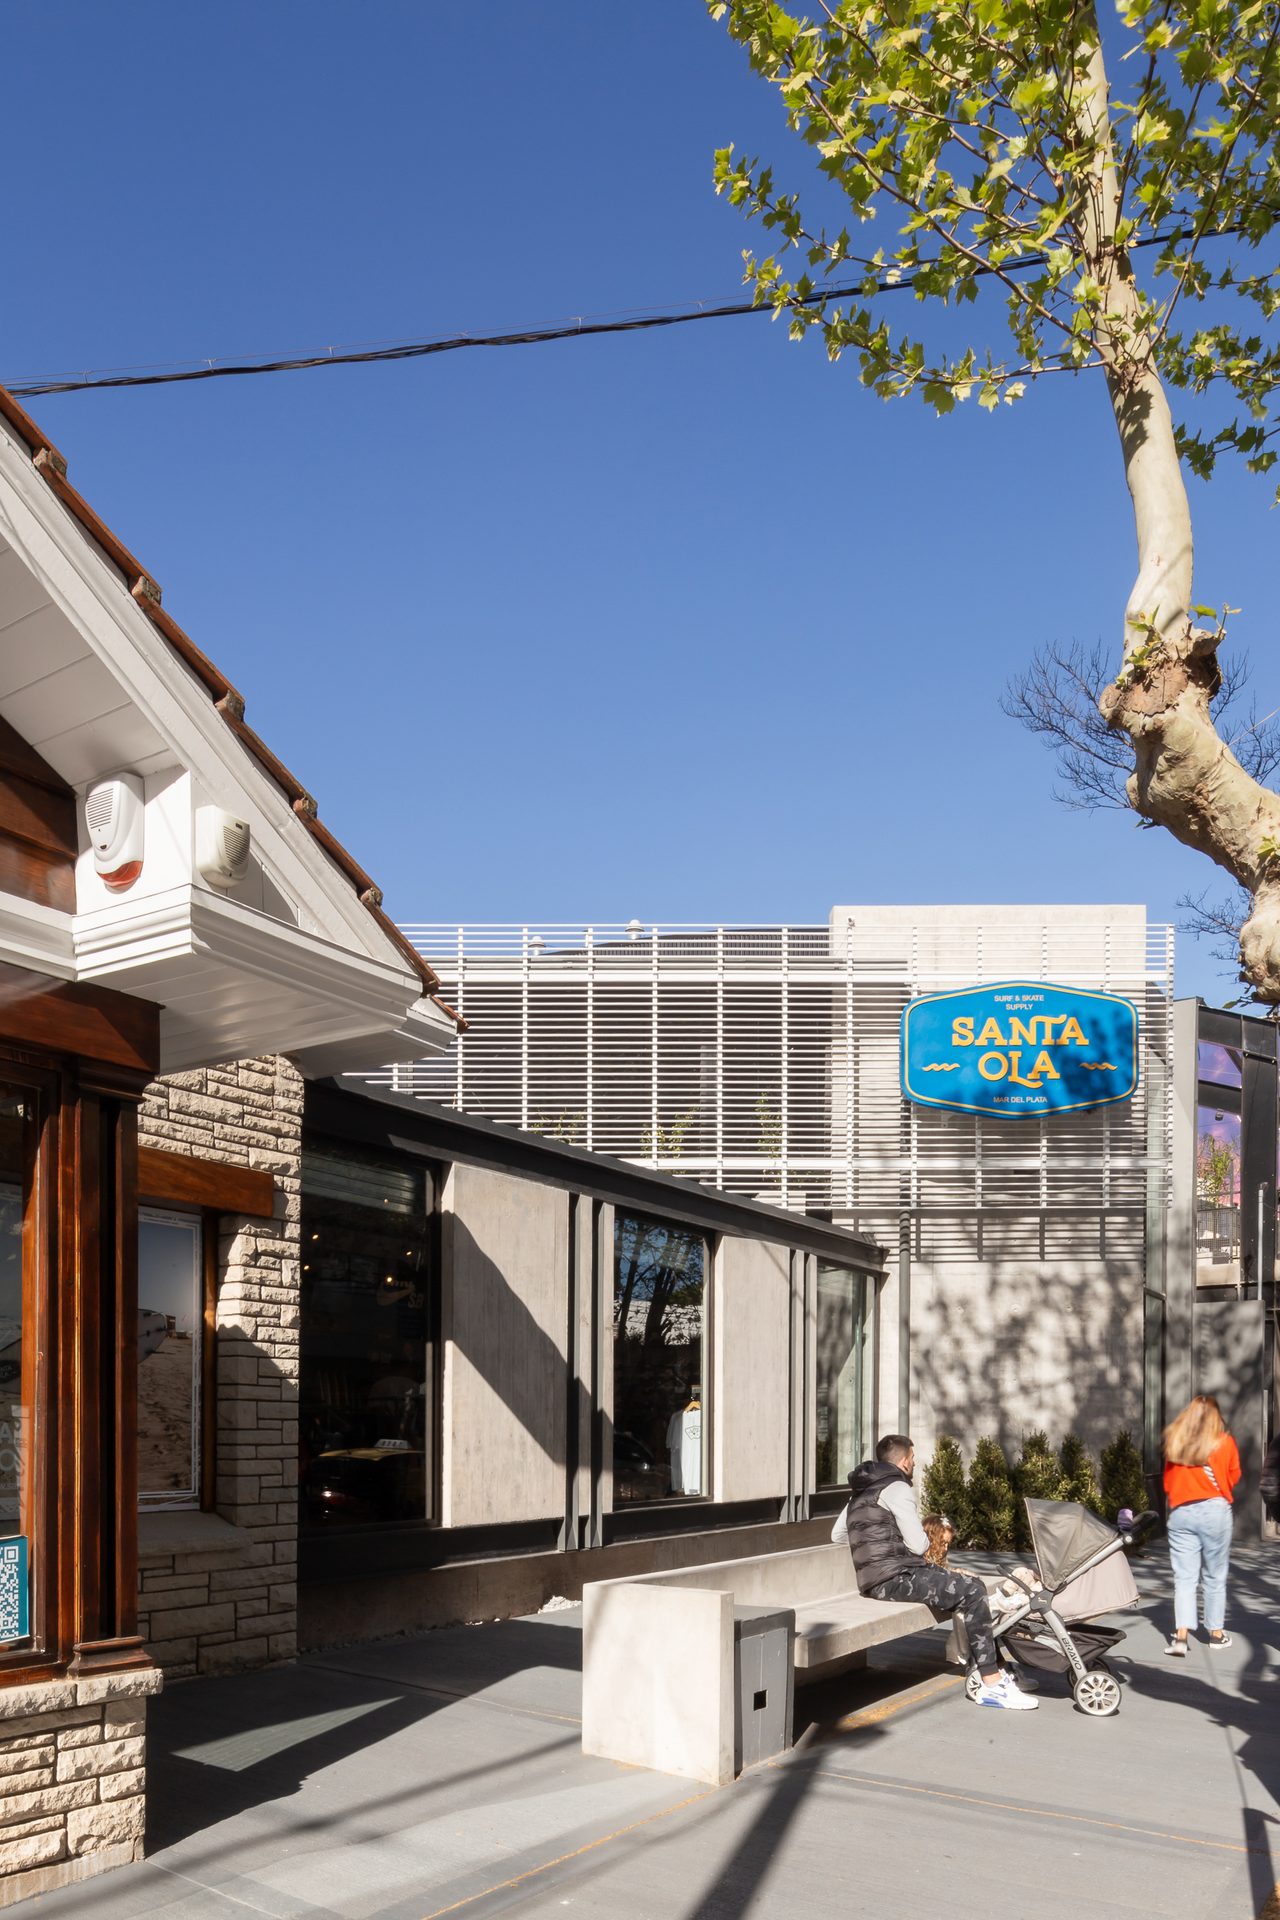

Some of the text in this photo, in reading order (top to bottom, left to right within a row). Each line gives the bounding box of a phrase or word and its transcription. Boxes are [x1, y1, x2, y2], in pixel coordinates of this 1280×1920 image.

[1006, 1003, 1033, 1011] SUPPLY
[952, 1014, 1089, 1047] SANTA
[978, 1050, 1061, 1089] OLA
[1061, 1637, 1082, 1670] BRAVO
